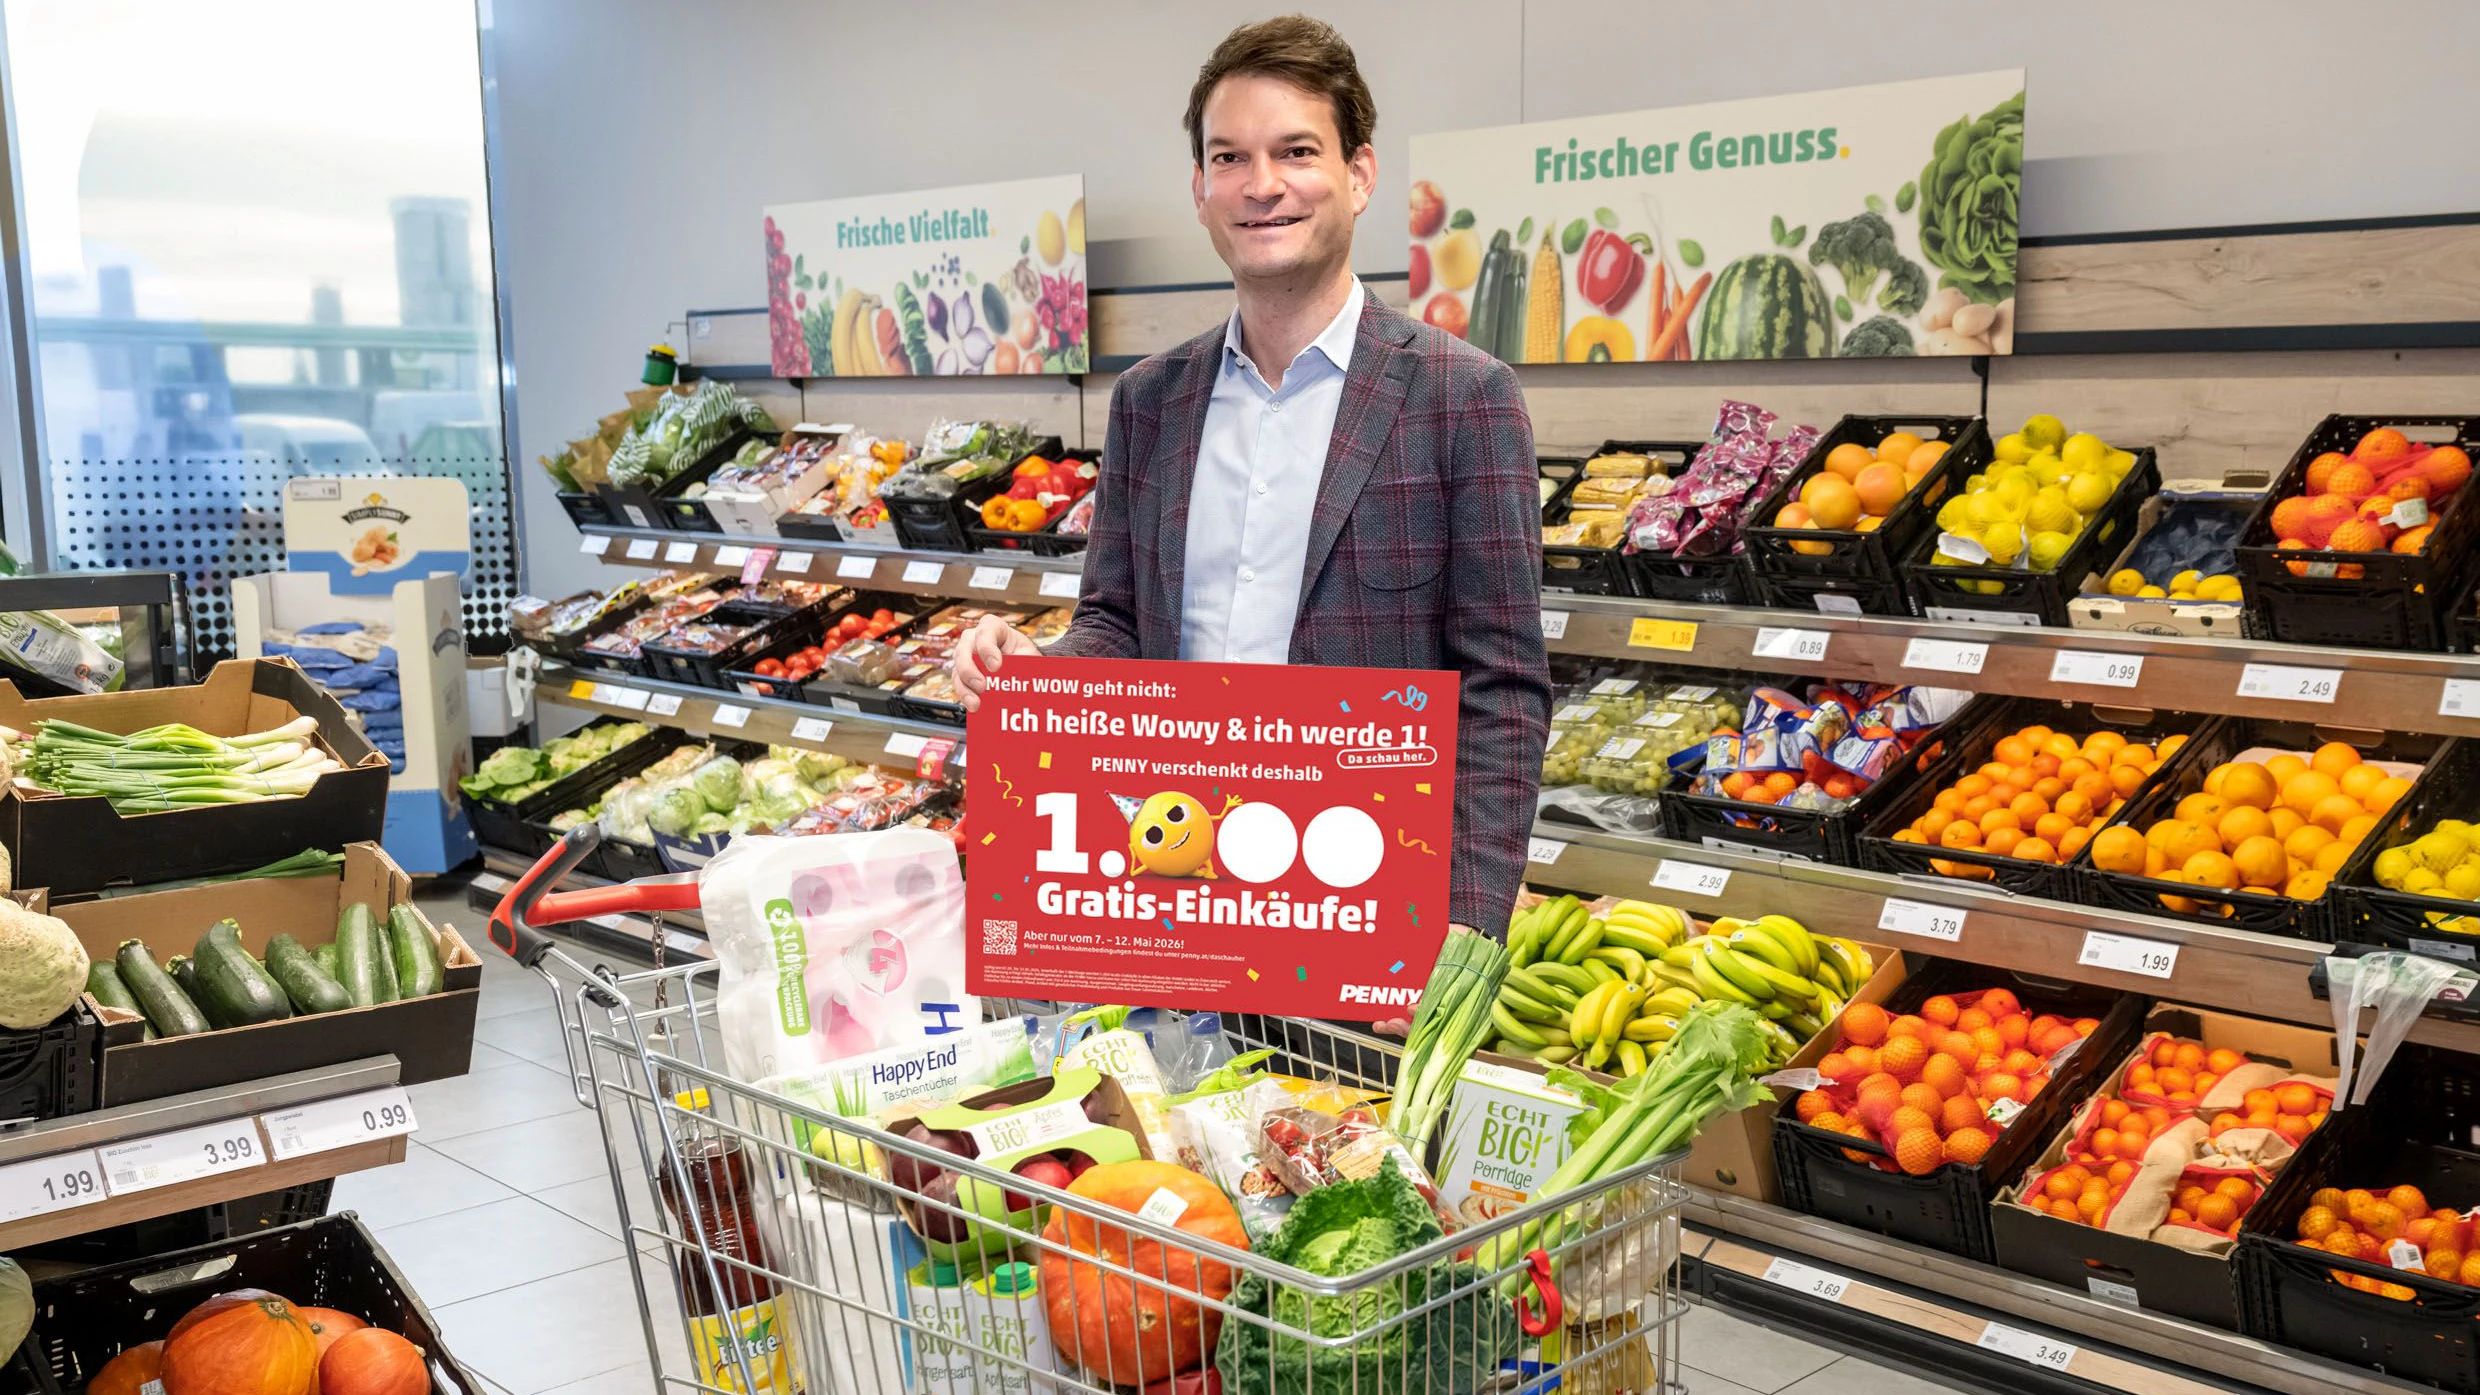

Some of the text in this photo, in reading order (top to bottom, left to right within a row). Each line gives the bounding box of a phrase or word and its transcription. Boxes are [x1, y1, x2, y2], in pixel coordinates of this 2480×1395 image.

[1536, 126, 1851, 184] Frischer Genuss.
[836, 215, 906, 248] Frische
[1799, 640, 1822, 655] 0.89
[1956, 652, 1981, 666] 1.79
[2107, 664, 2136, 680] 0.99
[985, 676, 1177, 698] Mehr WOW geht nicht:
[2299, 681, 2331, 696] 2.49
[1001, 708, 1427, 748] Ich heiße Wowy & ich werde 1!
[1348, 751, 1427, 764] Da schau her.
[1091, 757, 1323, 782] PENNY verschenkt deshalb
[1698, 874, 1722, 889] 2.99
[1036, 881, 1378, 933] Gratis-Einkäufe!
[1930, 917, 1957, 935] 3.79
[1023, 930, 1048, 941] Aber
[1050, 933, 1068, 942] nur
[1070, 934, 1093, 943] vom
[1095, 935, 1105, 944] 7.
[1115, 936, 1131, 946] 12.
[1133, 937, 1152, 947] Mai
[1154, 938, 1185, 949] 2026!
[1040, 943, 1055, 951] Infos
[2142, 953, 2170, 971] 1.99
[1339, 984, 1424, 1006] PENNY
[873, 1058, 925, 1085] Happy
[926, 1044, 957, 1071] End
[882, 1075, 958, 1102] Taschentücher
[363, 1104, 407, 1130] 0.99
[1487, 1100, 1552, 1129] ECHT
[204, 1136, 252, 1165] 3.99
[43, 1170, 94, 1201] 1.99
[1473, 1160, 1533, 1190] Porridge
[1813, 1279, 1841, 1297] 3.69
[719, 1334, 779, 1366] Eitee
[2036, 1345, 2068, 1365] 3.49
